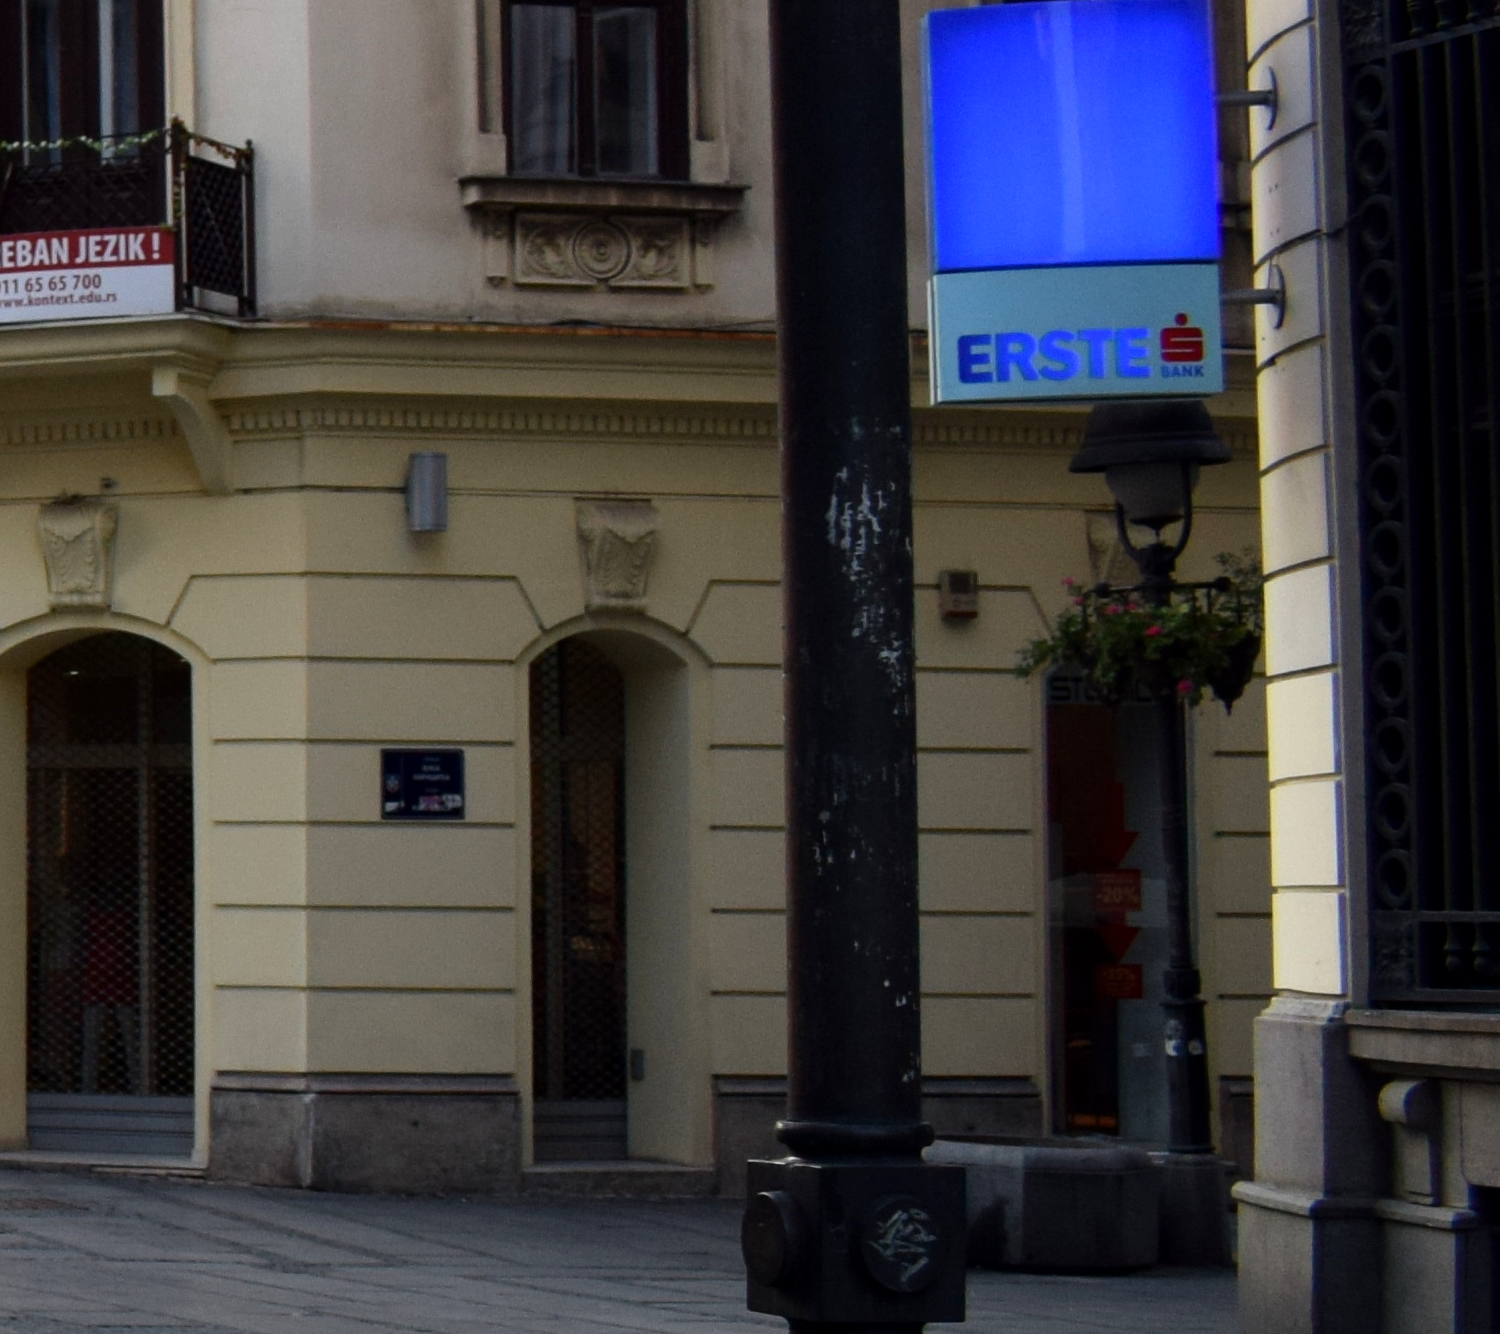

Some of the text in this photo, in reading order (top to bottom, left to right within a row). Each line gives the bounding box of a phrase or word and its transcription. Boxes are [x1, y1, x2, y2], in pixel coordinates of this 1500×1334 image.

[74, 233, 146, 264] JEZIK
[24, 276, 42, 294] 65
[48, 275, 67, 292] 65
[72, 274, 102, 291] 700
[957, 327, 1151, 384] ERSTE
[1160, 363, 1205, 379] BANK
